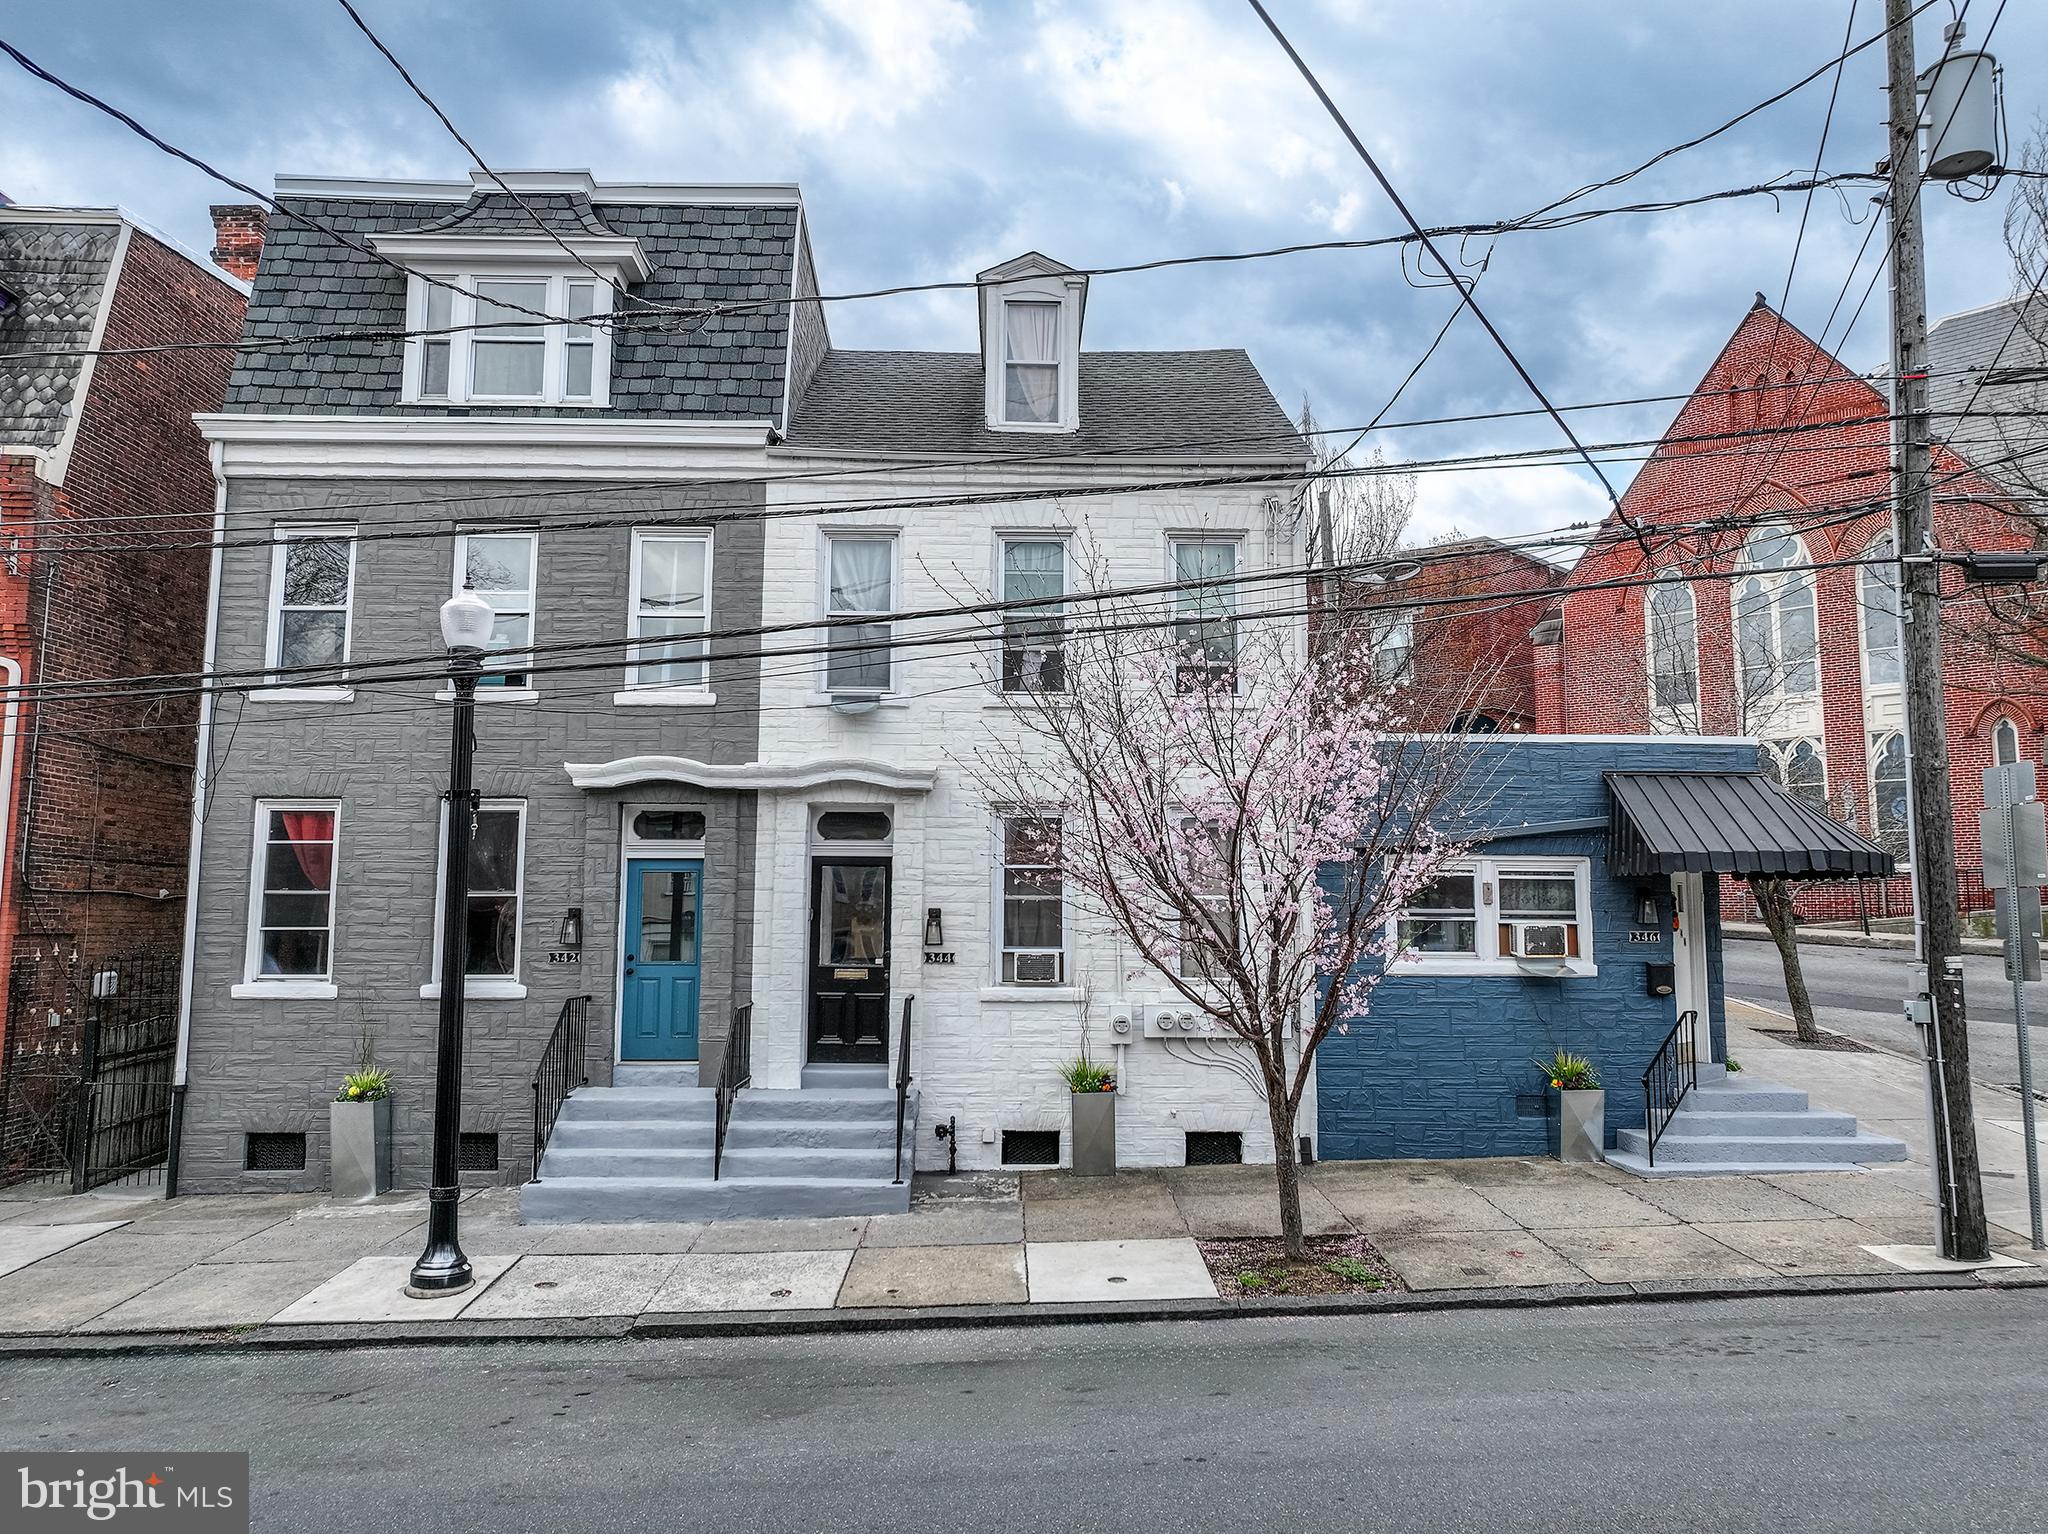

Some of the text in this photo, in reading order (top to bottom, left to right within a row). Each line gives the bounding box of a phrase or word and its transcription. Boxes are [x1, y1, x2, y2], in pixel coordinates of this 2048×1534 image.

[1632, 931, 1657, 942] 346
[552, 953, 577, 963] 342
[928, 952, 952, 963] 344
